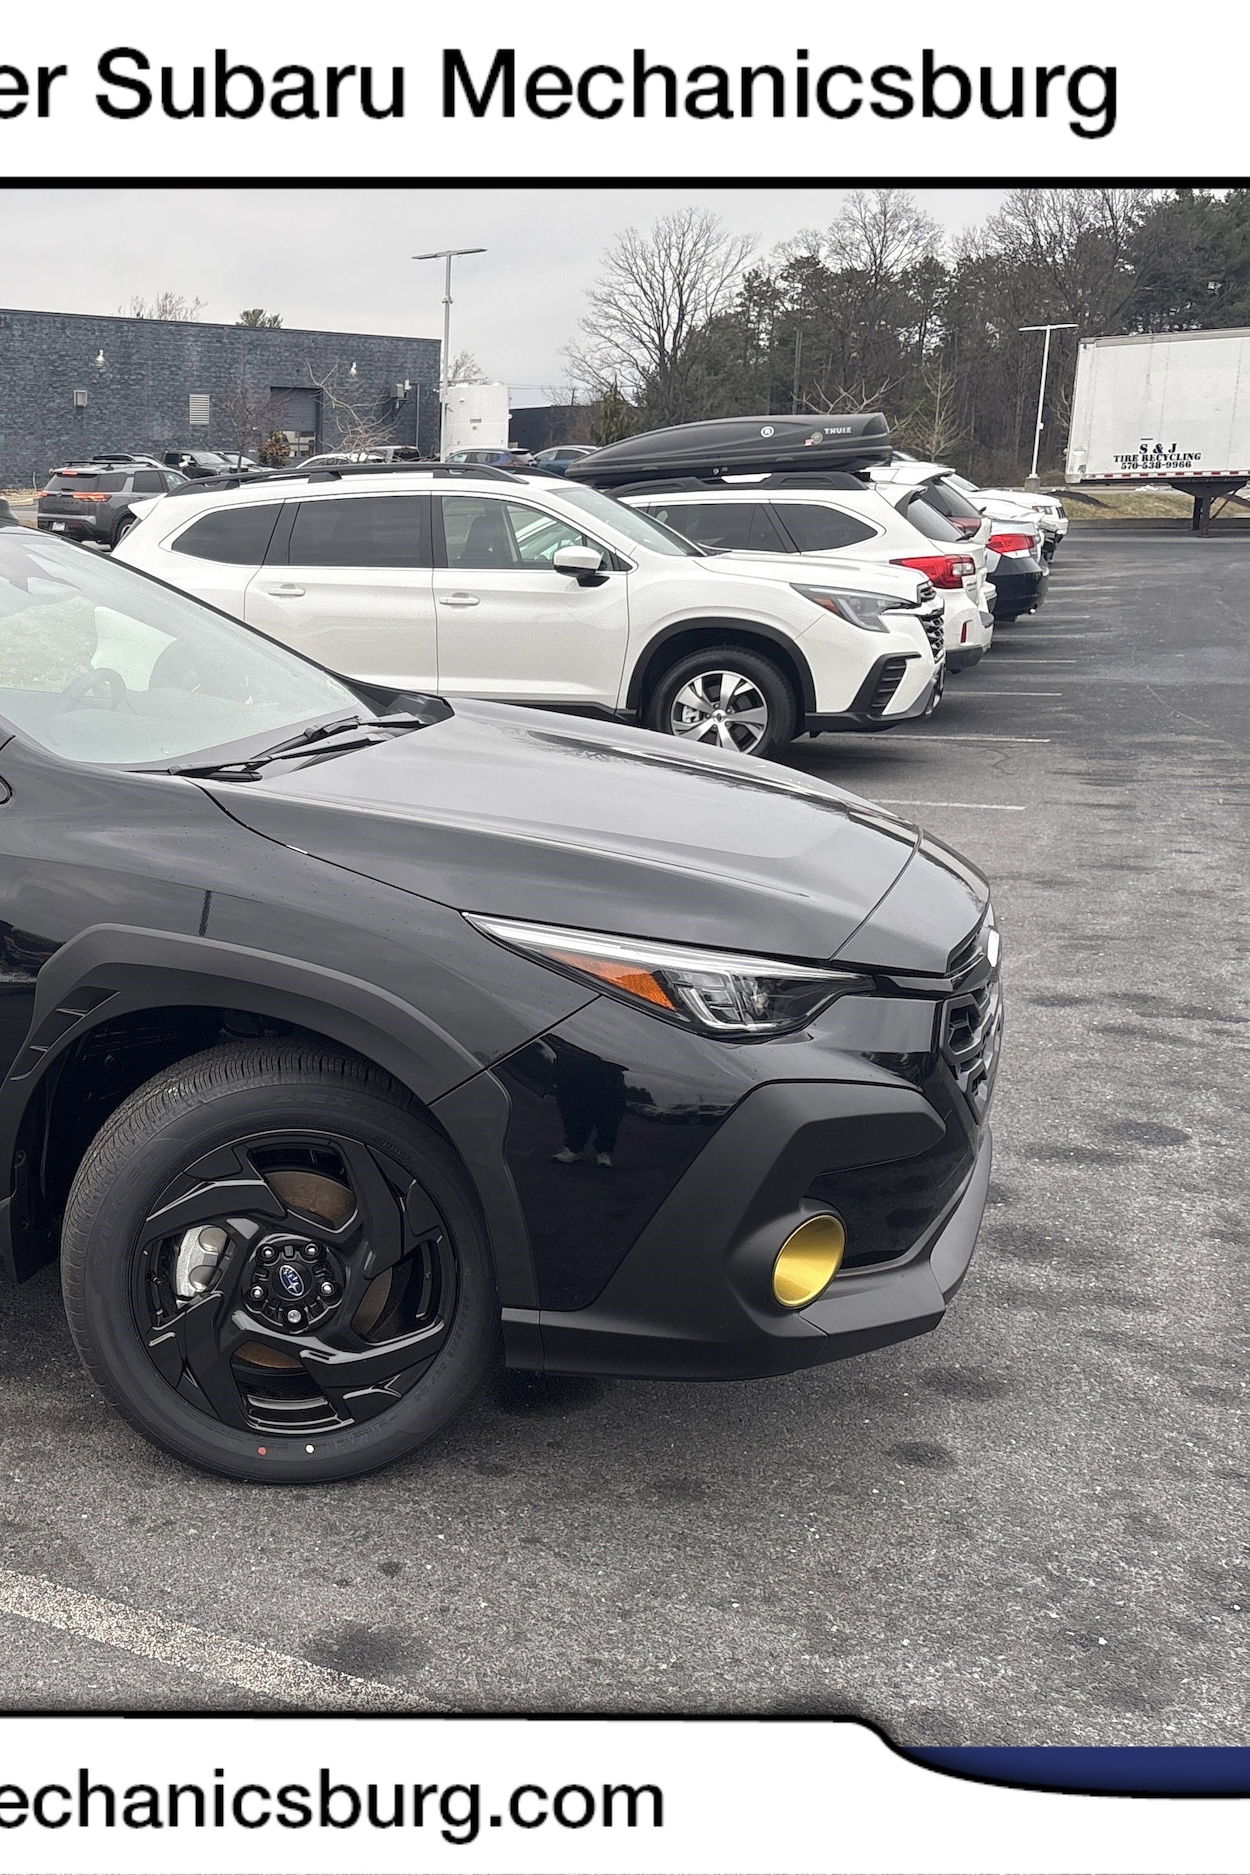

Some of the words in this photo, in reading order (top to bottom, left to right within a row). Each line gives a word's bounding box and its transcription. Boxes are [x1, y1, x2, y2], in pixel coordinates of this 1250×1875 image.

[823, 426, 852, 435] THULE
[1138, 444, 1148, 454] S
[1153, 443, 1164, 454] &
[1168, 443, 1177, 454] J
[1113, 454, 1139, 463] TIRE
[1141, 452, 1202, 462] RECYCLING
[1120, 460, 1192, 470] 570-538-9966
